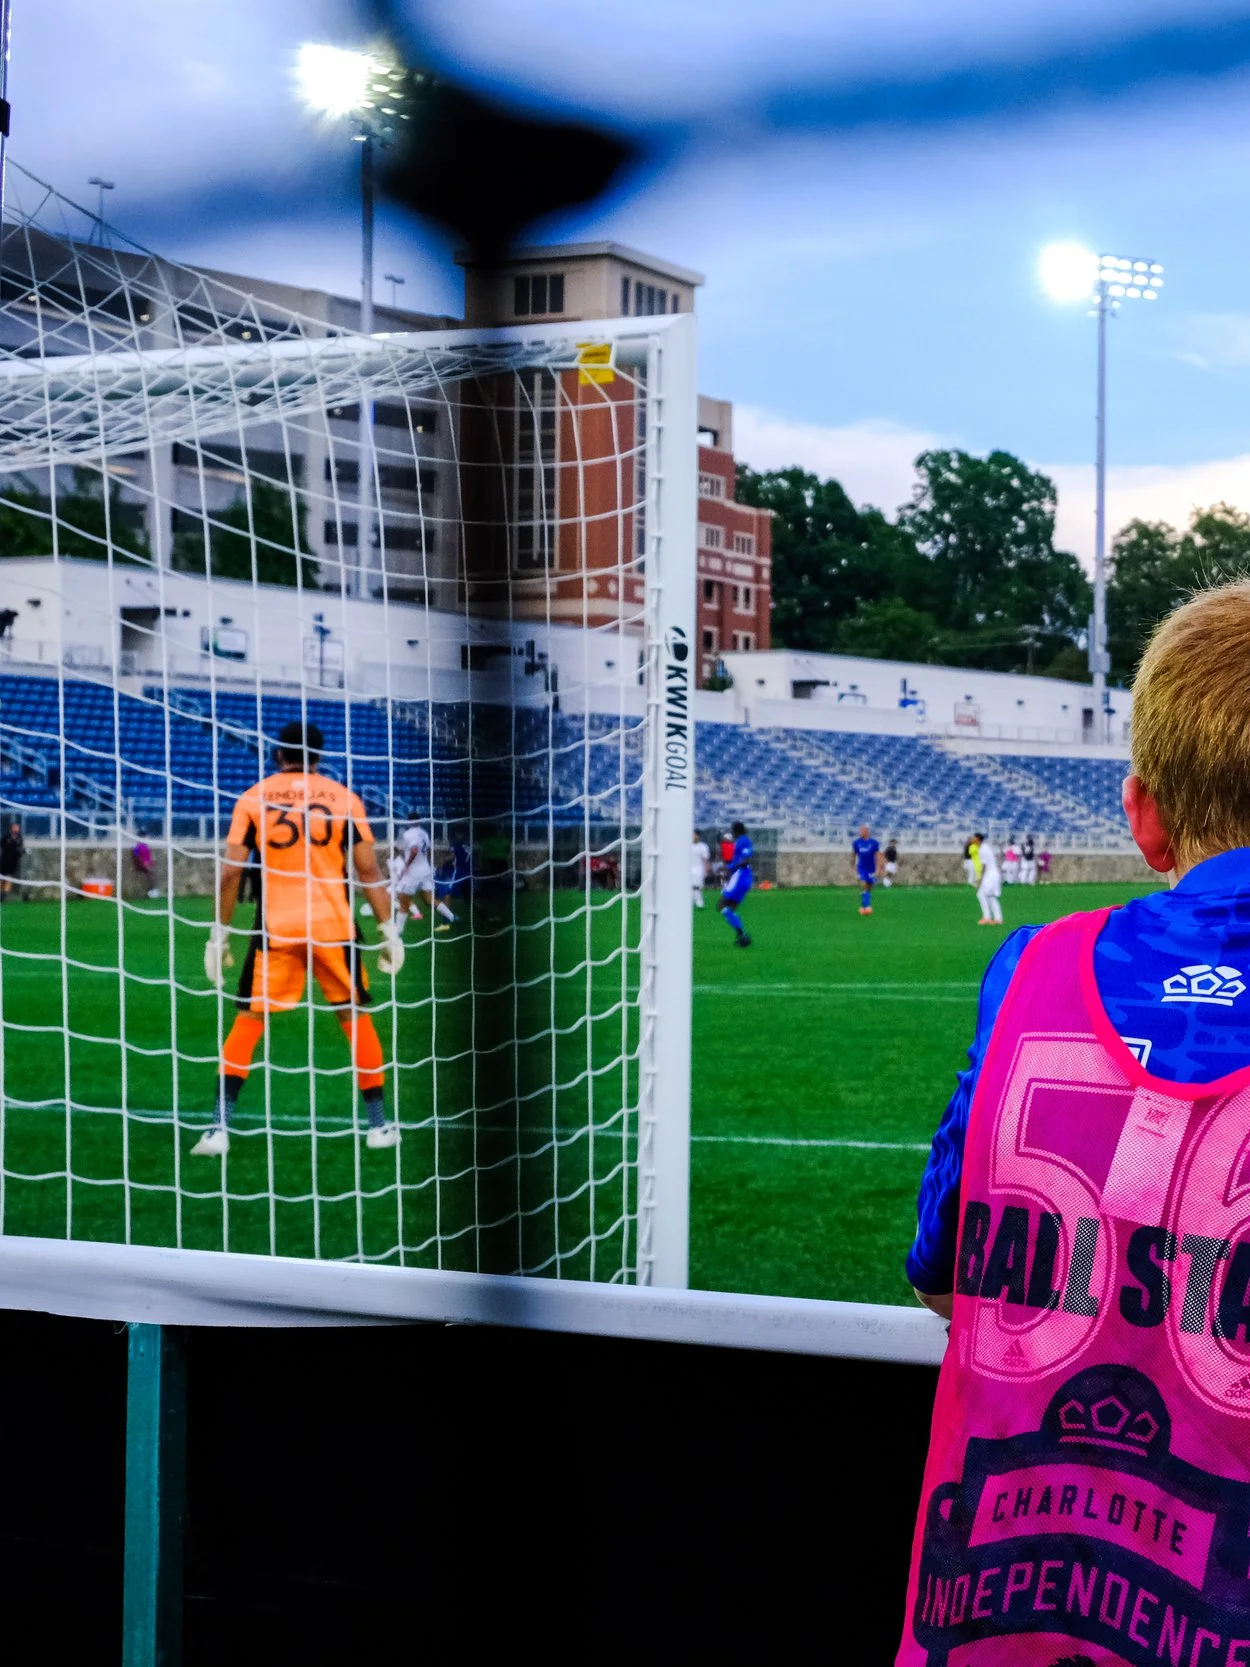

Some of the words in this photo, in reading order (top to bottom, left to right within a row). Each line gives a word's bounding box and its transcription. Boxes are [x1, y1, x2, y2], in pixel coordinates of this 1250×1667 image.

[266, 802, 333, 849] 30
[956, 1201, 1102, 1317] BALL
[992, 1484, 1187, 1557] CHARLOTTE
